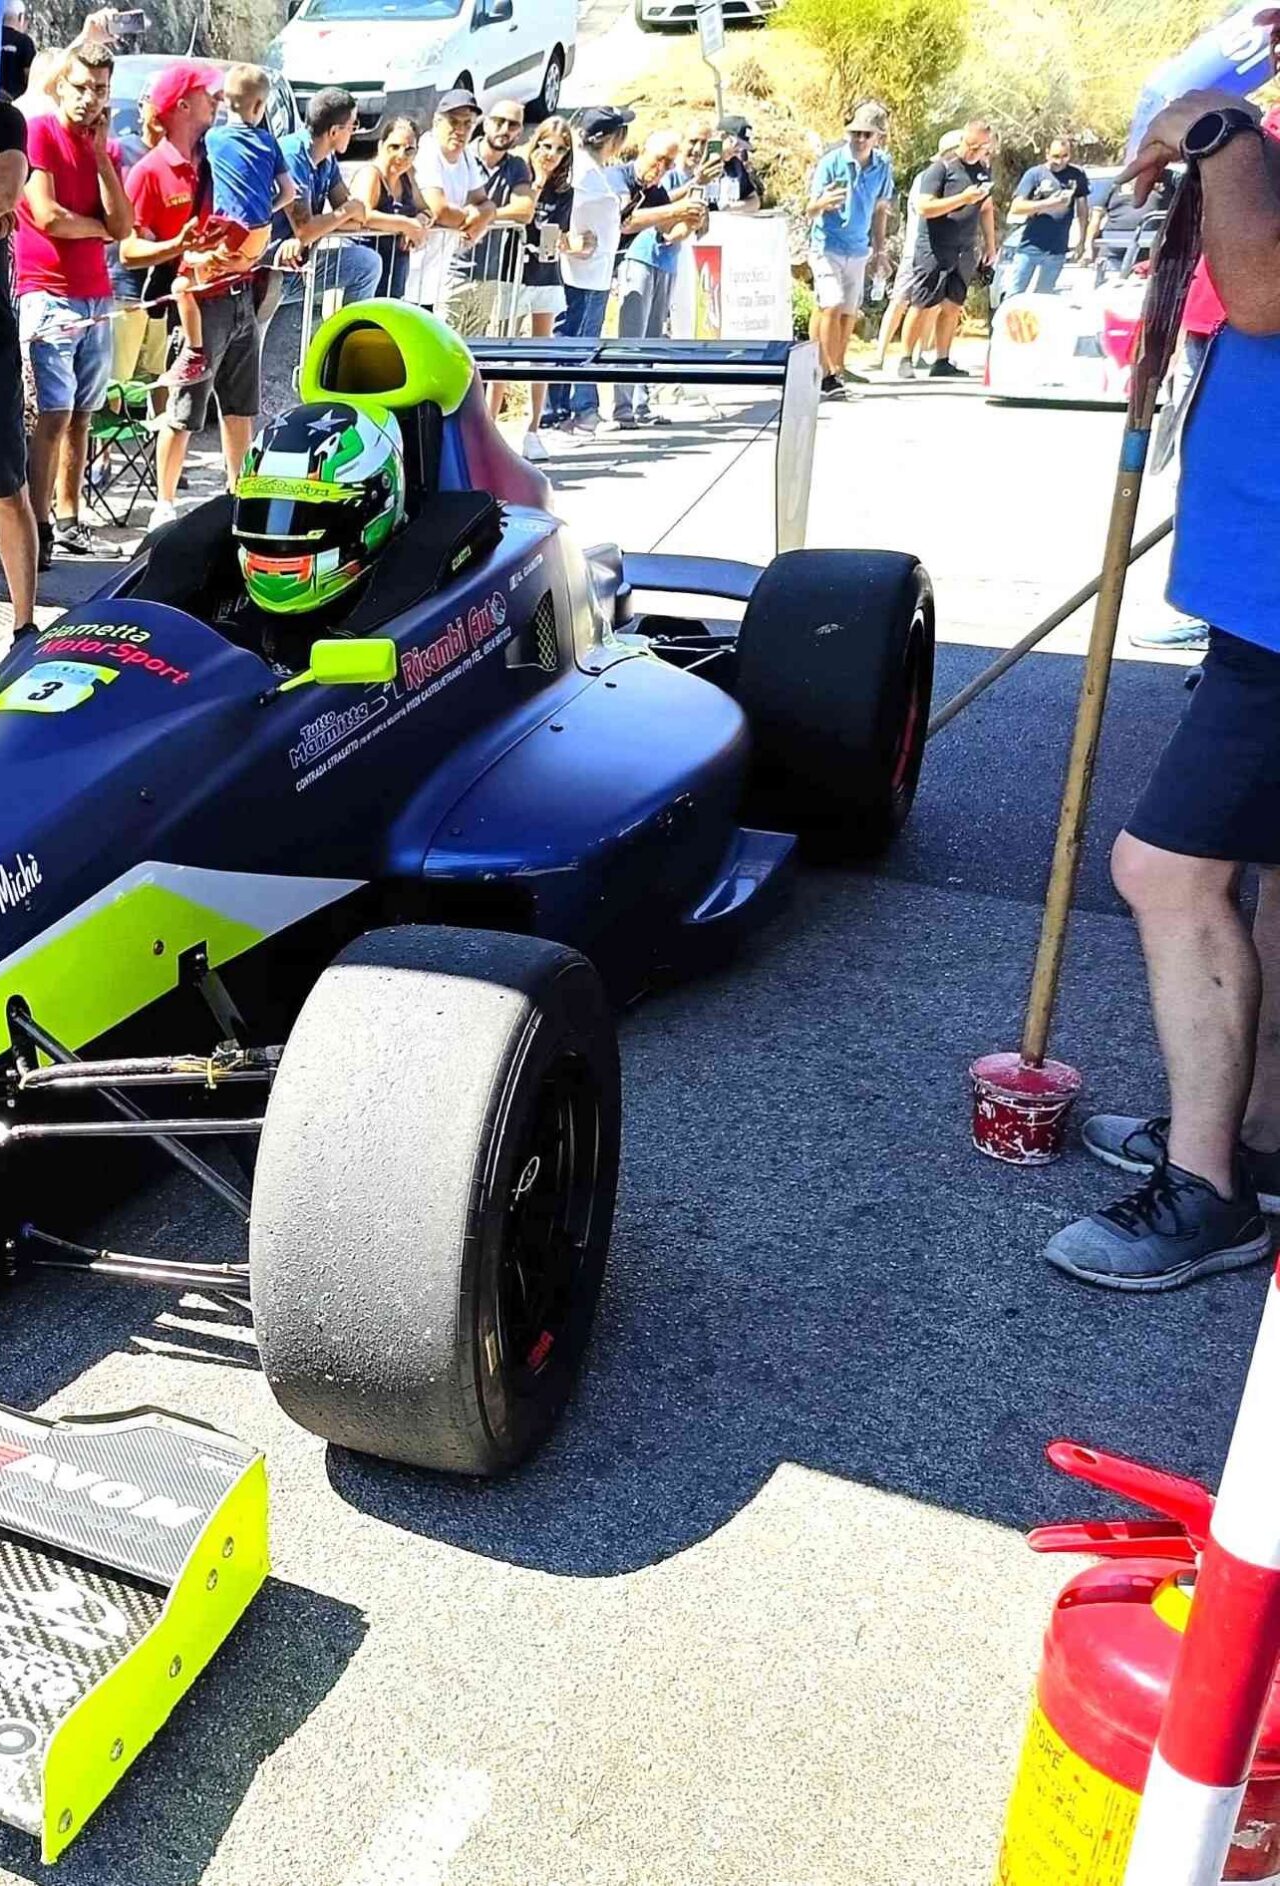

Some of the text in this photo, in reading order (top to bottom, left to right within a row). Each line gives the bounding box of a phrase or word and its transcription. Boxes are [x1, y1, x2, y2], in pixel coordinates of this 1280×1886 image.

[35, 622, 151, 645] Giametta
[32, 636, 190, 685] MotorSport
[401, 617, 467, 690] Ricambi
[26, 681, 64, 701] 3
[296, 762, 327, 792] CONTRADA
[2, 1453, 205, 1529] AVON
